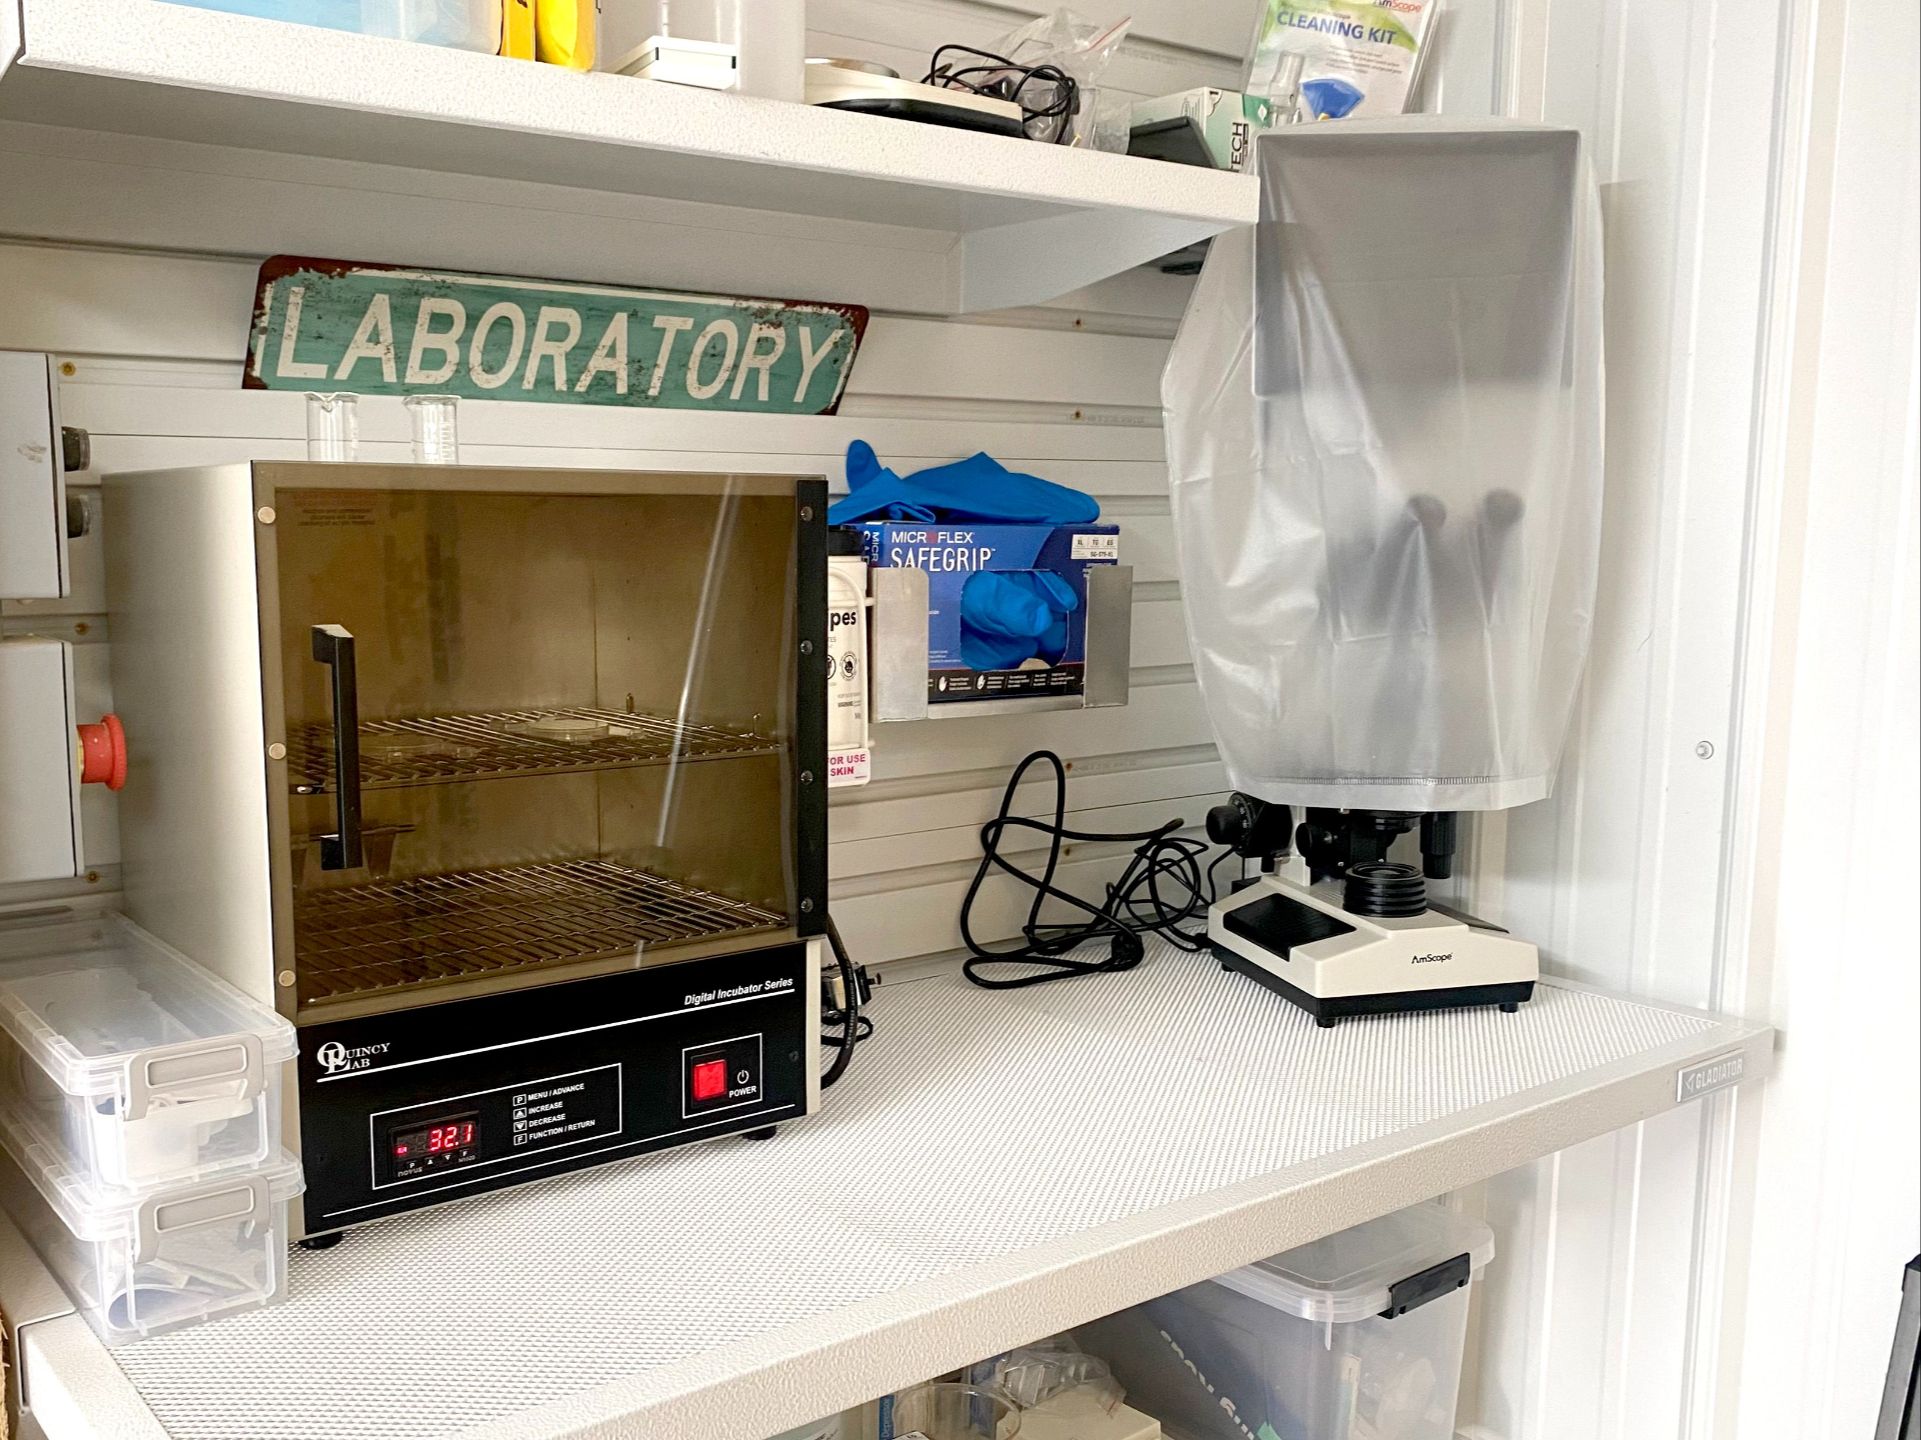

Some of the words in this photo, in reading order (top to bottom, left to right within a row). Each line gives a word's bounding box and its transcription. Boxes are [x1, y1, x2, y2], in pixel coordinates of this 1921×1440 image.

[1276, 11, 1364, 40] CLEANING
[1368, 27, 1397, 45] KIT
[275, 286, 844, 403] LABORATORY
[827, 755, 844, 766] OR
[846, 753, 866, 764] USE
[829, 766, 855, 777] SKIN
[1411, 953, 1453, 965] AmScope
[684, 990, 716, 1006] Digital
[717, 983, 763, 1000] Incubator
[764, 978, 794, 991] Series
[316, 1041, 391, 1067] QUINCY
[1695, 1058, 1743, 1090] GLADIATOR
[528, 1091, 548, 1101] MENU
[552, 1083, 585, 1096] ADVANCE
[729, 1085, 757, 1098] POWER
[528, 1101, 563, 1114] INCREASE
[528, 1113, 566, 1128] DECREASE
[529, 1126, 564, 1140] FUNCTION
[567, 1119, 596, 1131] RETURN
[429, 1123, 473, 1151] 32.1
